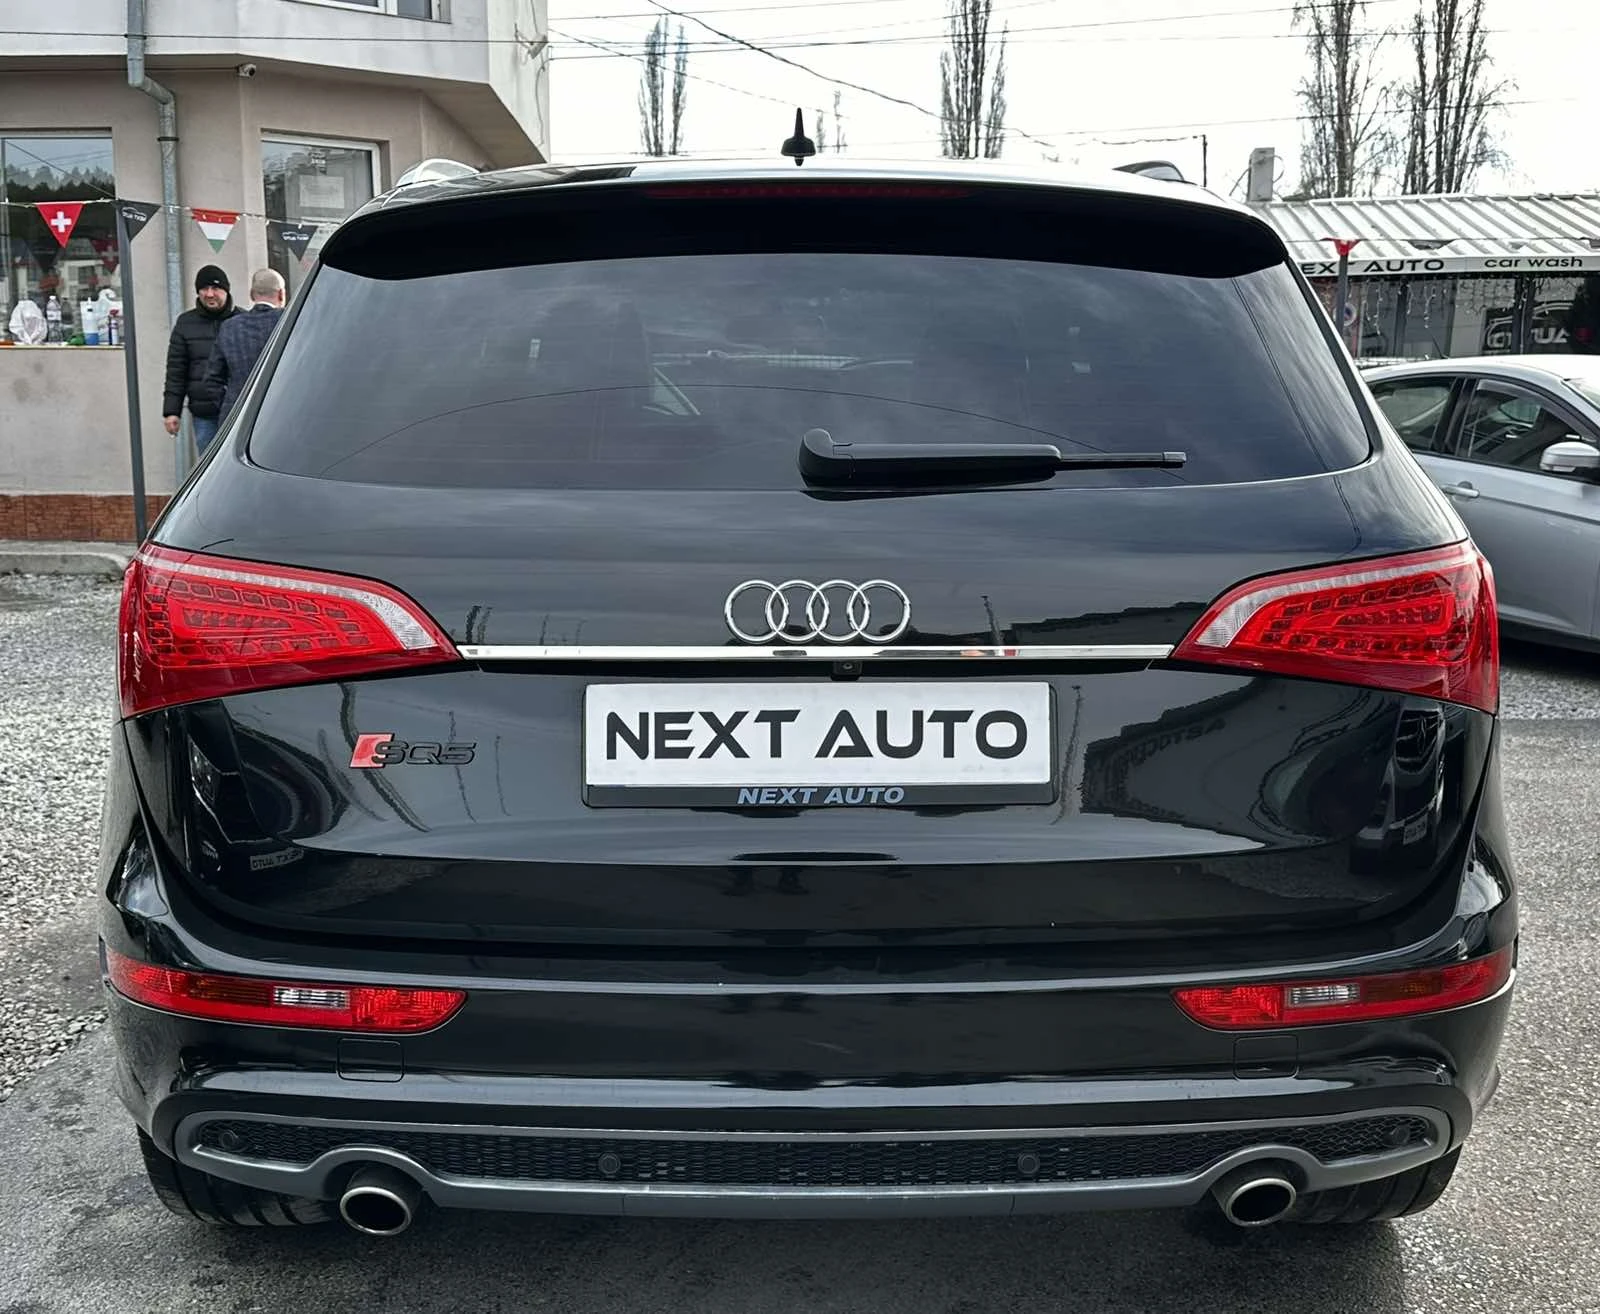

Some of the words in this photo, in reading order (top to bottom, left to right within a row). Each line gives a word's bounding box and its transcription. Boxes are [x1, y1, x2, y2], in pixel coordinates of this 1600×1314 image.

[1363, 259, 1445, 273] AUTO
[1484, 258, 1520, 268] car
[1527, 256, 1583, 268] wash
[606, 709, 801, 760] NEXT
[814, 709, 1028, 760] AUTO
[737, 787, 818, 805] NEXT
[824, 787, 905, 805] AUTO
